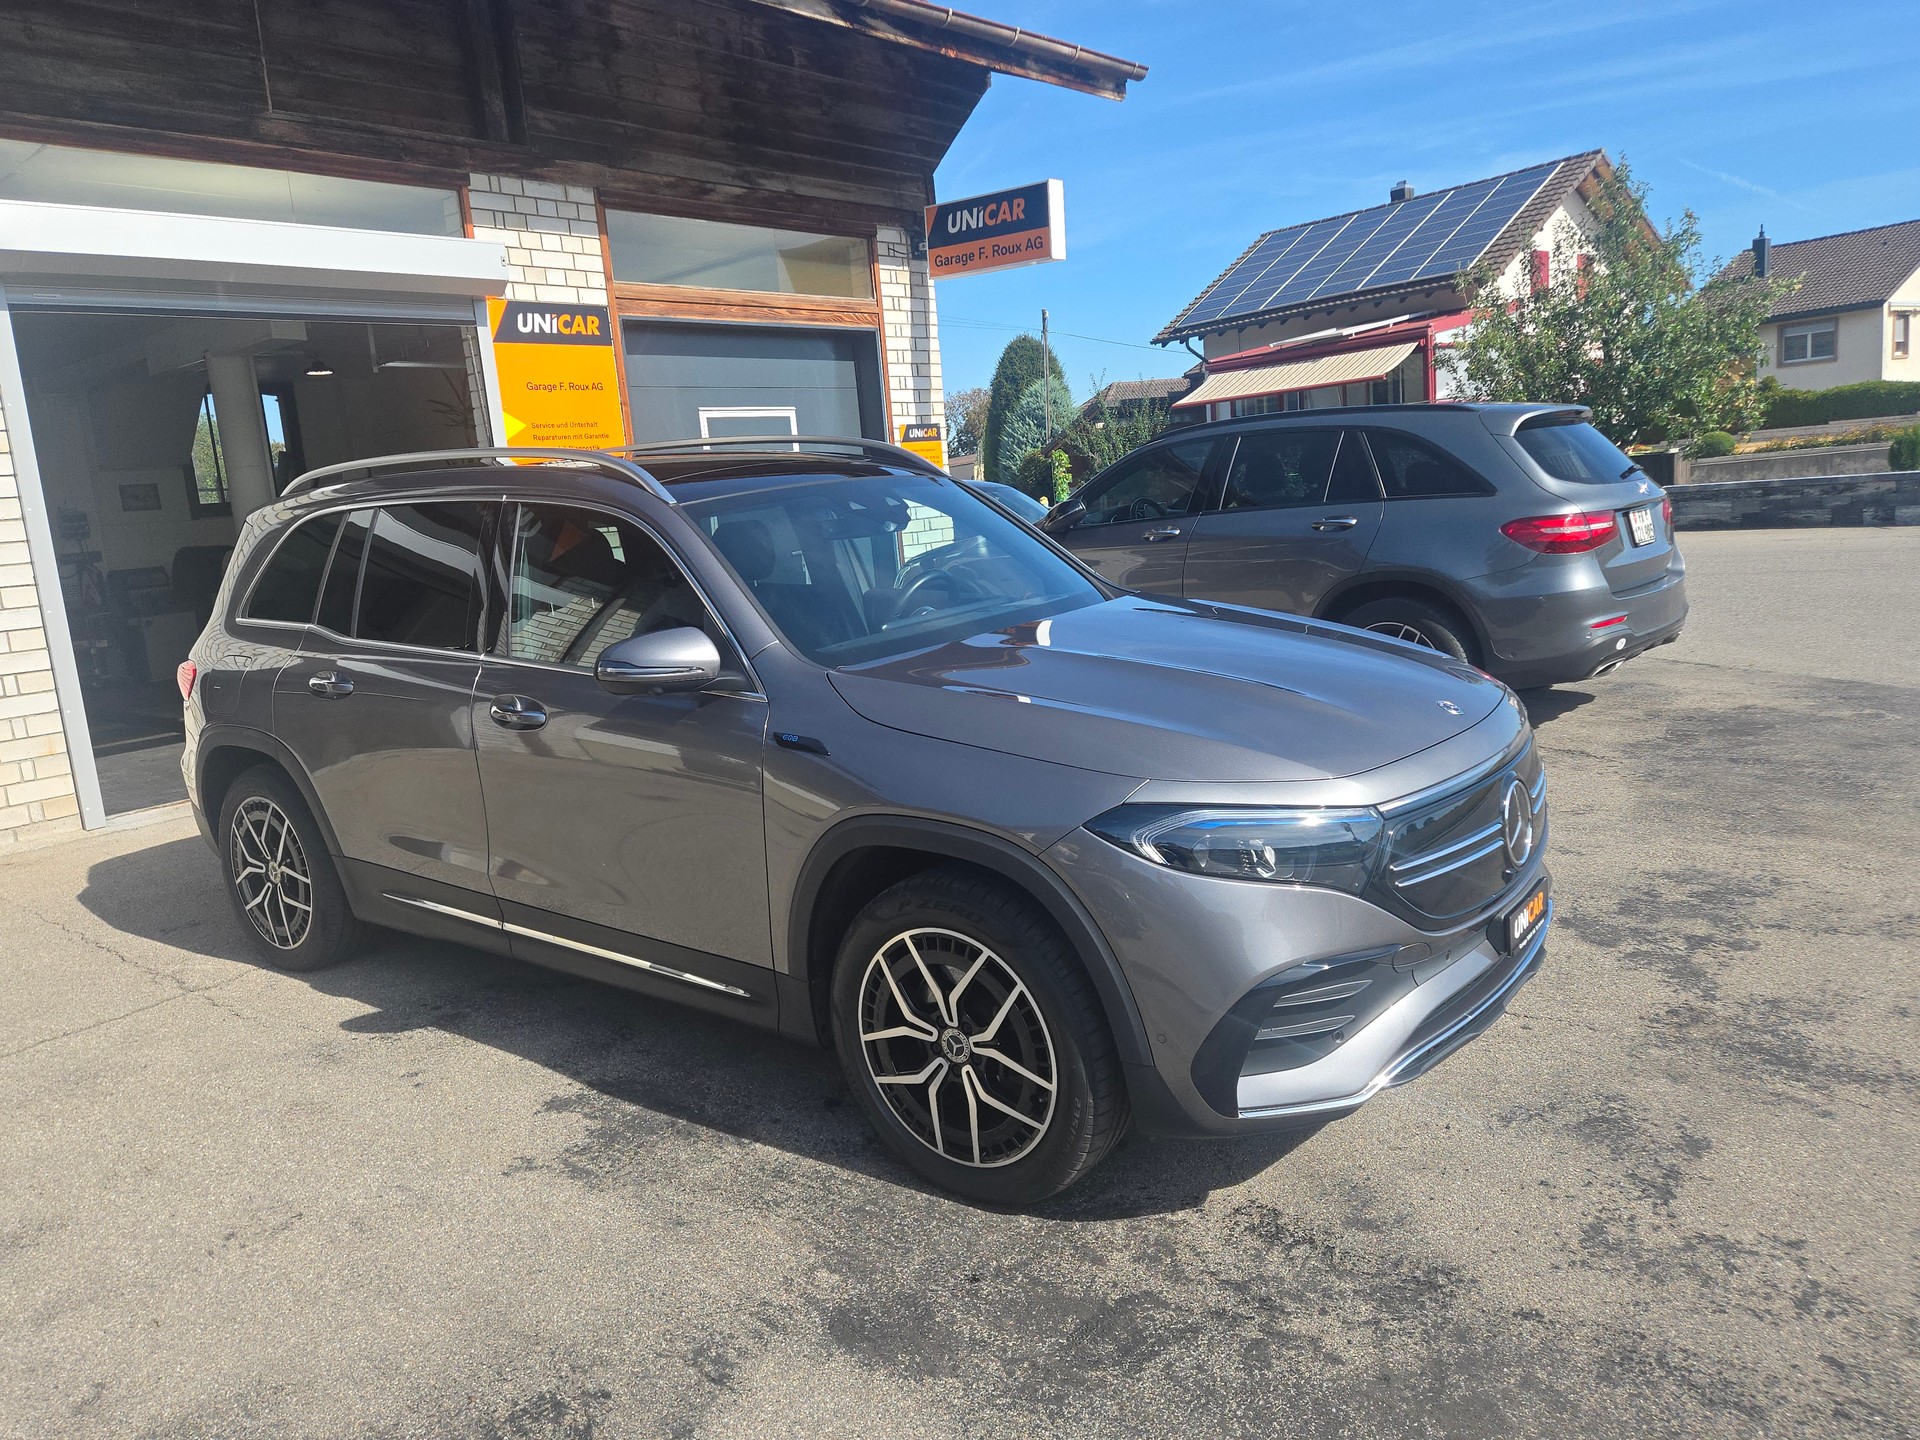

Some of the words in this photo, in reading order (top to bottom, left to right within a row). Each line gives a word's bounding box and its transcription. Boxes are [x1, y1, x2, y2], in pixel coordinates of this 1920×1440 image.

[934, 251, 975, 268] Garage
[978, 246, 989, 260] F.
[992, 243, 1022, 257] Roux
[1025, 236, 1043, 251] AG
[526, 382, 557, 393] Garage
[559, 382, 567, 391] F.
[569, 382, 590, 391] Roux
[591, 382, 604, 391] AG
[533, 434, 571, 442] Reparaturen
[584, 432, 610, 440] Garantie
[782, 733, 799, 742] EQB
